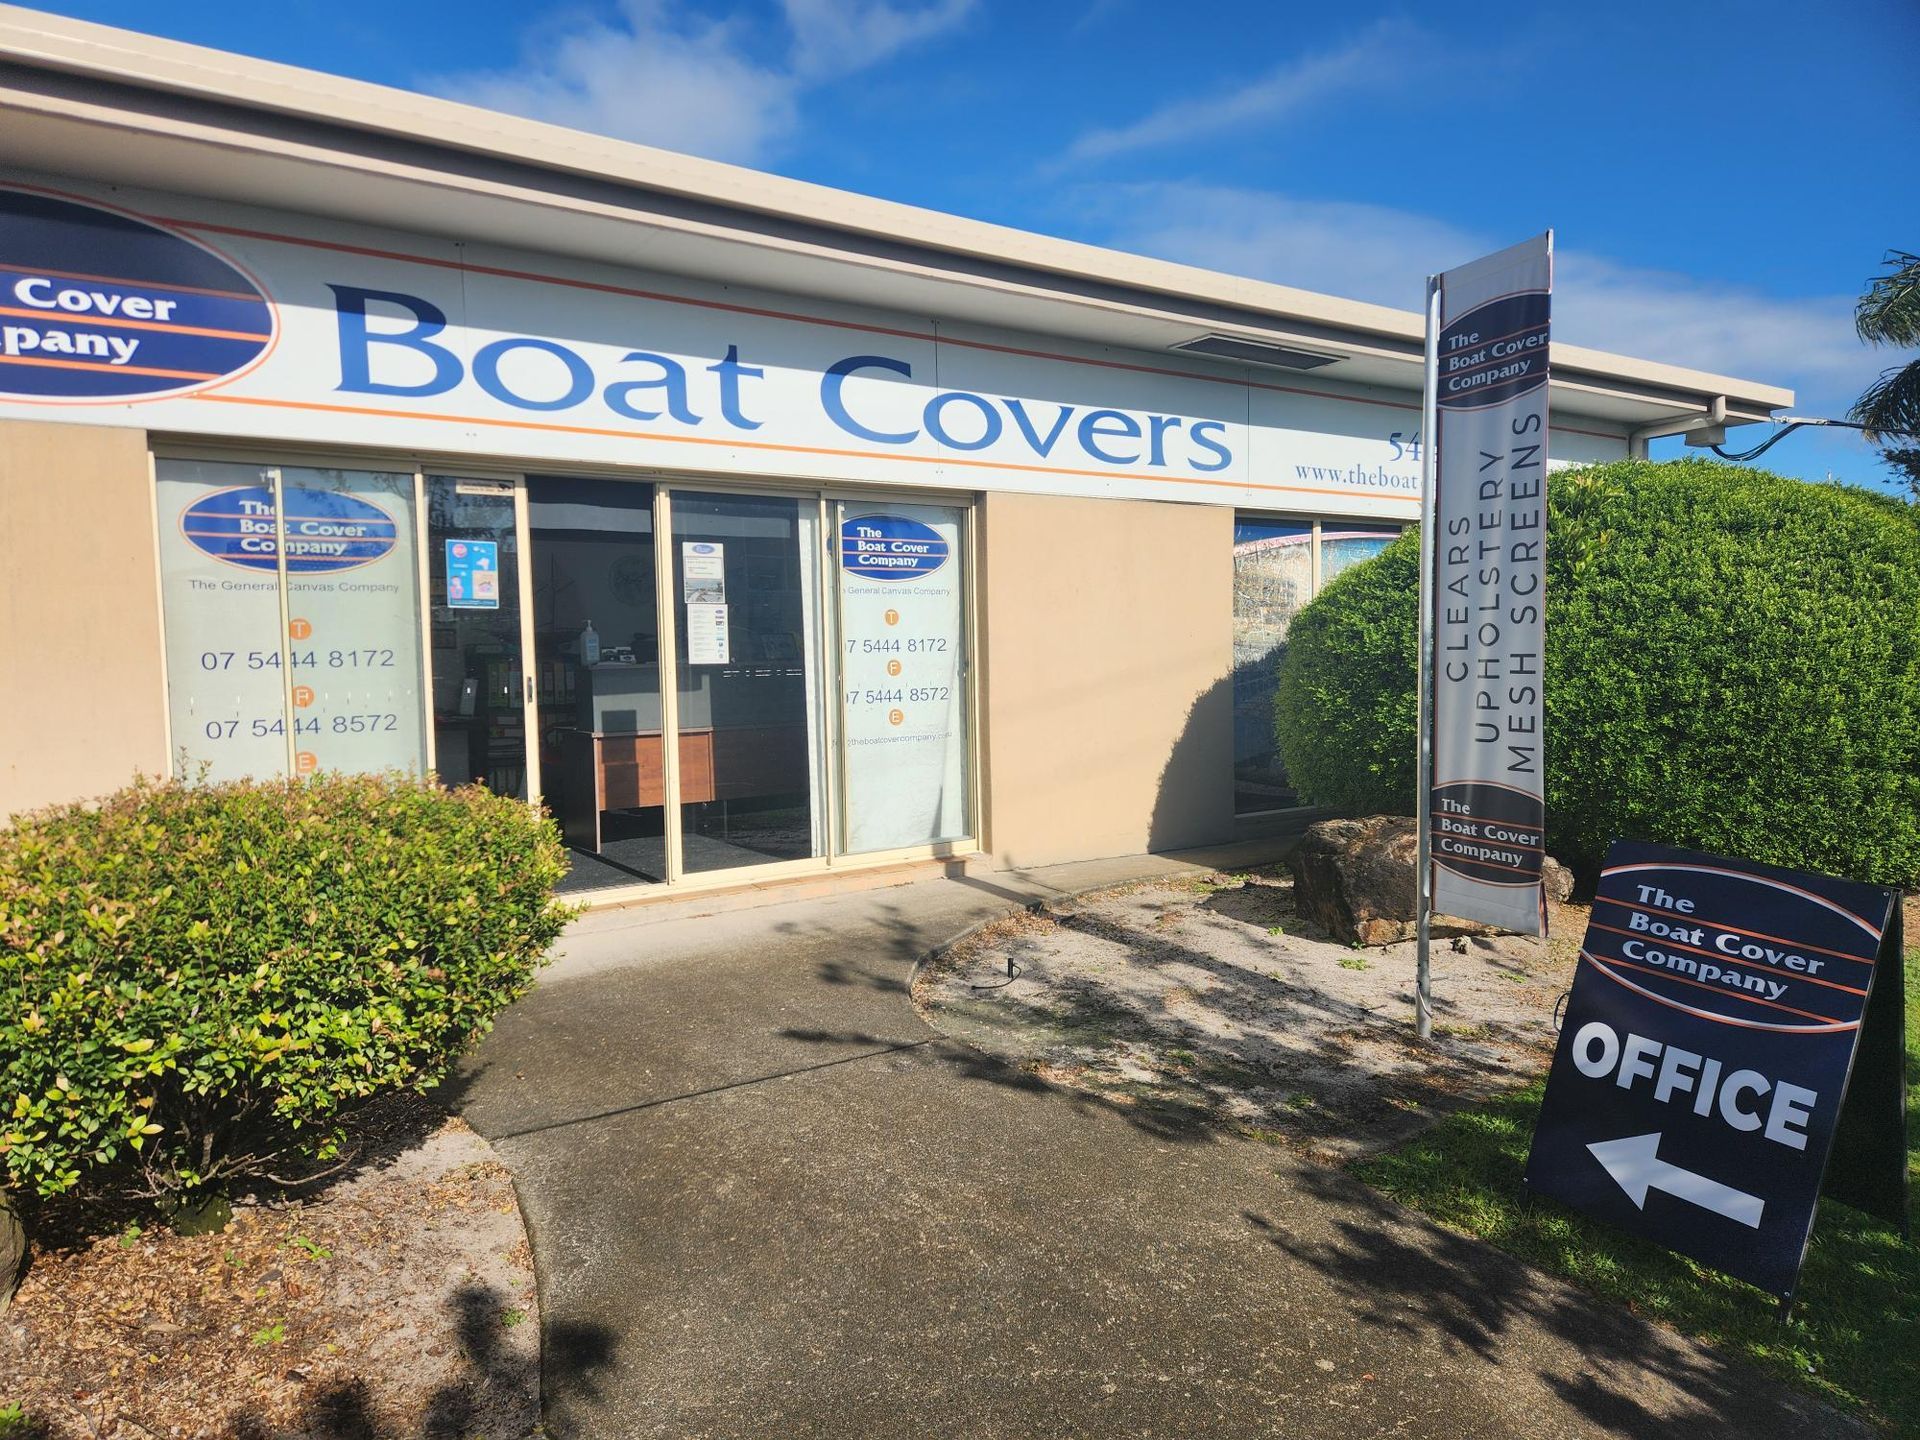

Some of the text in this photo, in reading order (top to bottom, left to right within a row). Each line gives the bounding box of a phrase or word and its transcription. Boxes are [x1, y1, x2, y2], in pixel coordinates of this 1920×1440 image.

[14, 278, 177, 321] Cover
[0, 326, 140, 365] pany
[1449, 332, 1480, 350] The
[1449, 332, 1548, 371] Boat Cover
[324, 282, 1232, 472] Boat Covers
[1448, 359, 1531, 392] Company
[1388, 431, 1422, 462] 54
[1295, 463, 1422, 489] www.theboat
[300, 521, 367, 537] Cover
[857, 526, 882, 538] The
[857, 540, 929, 553] Boat Cover
[858, 554, 919, 567] Company
[188, 579, 216, 591] The
[221, 580, 278, 592] General
[338, 582, 399, 594] Company
[1446, 516, 1470, 683] CLEARS
[1475, 450, 1504, 743] UPHOLSTERY
[1507, 413, 1542, 773] MESH SCREENS
[201, 652, 235, 670] 07
[328, 650, 395, 668] 8172
[844, 638, 947, 653] 7 5444 8172
[846, 686, 950, 704] 7 5444 8572
[206, 721, 239, 739] 07
[332, 714, 398, 733] 8572
[1441, 798, 1471, 815] The
[1441, 818, 1539, 846] Boat Cover
[1441, 838, 1523, 867] Company
[1636, 884, 1695, 914] The
[1628, 911, 1825, 975] Boat Cover
[1622, 940, 1789, 1000] Company
[1572, 1021, 1818, 1151] OFFICE
